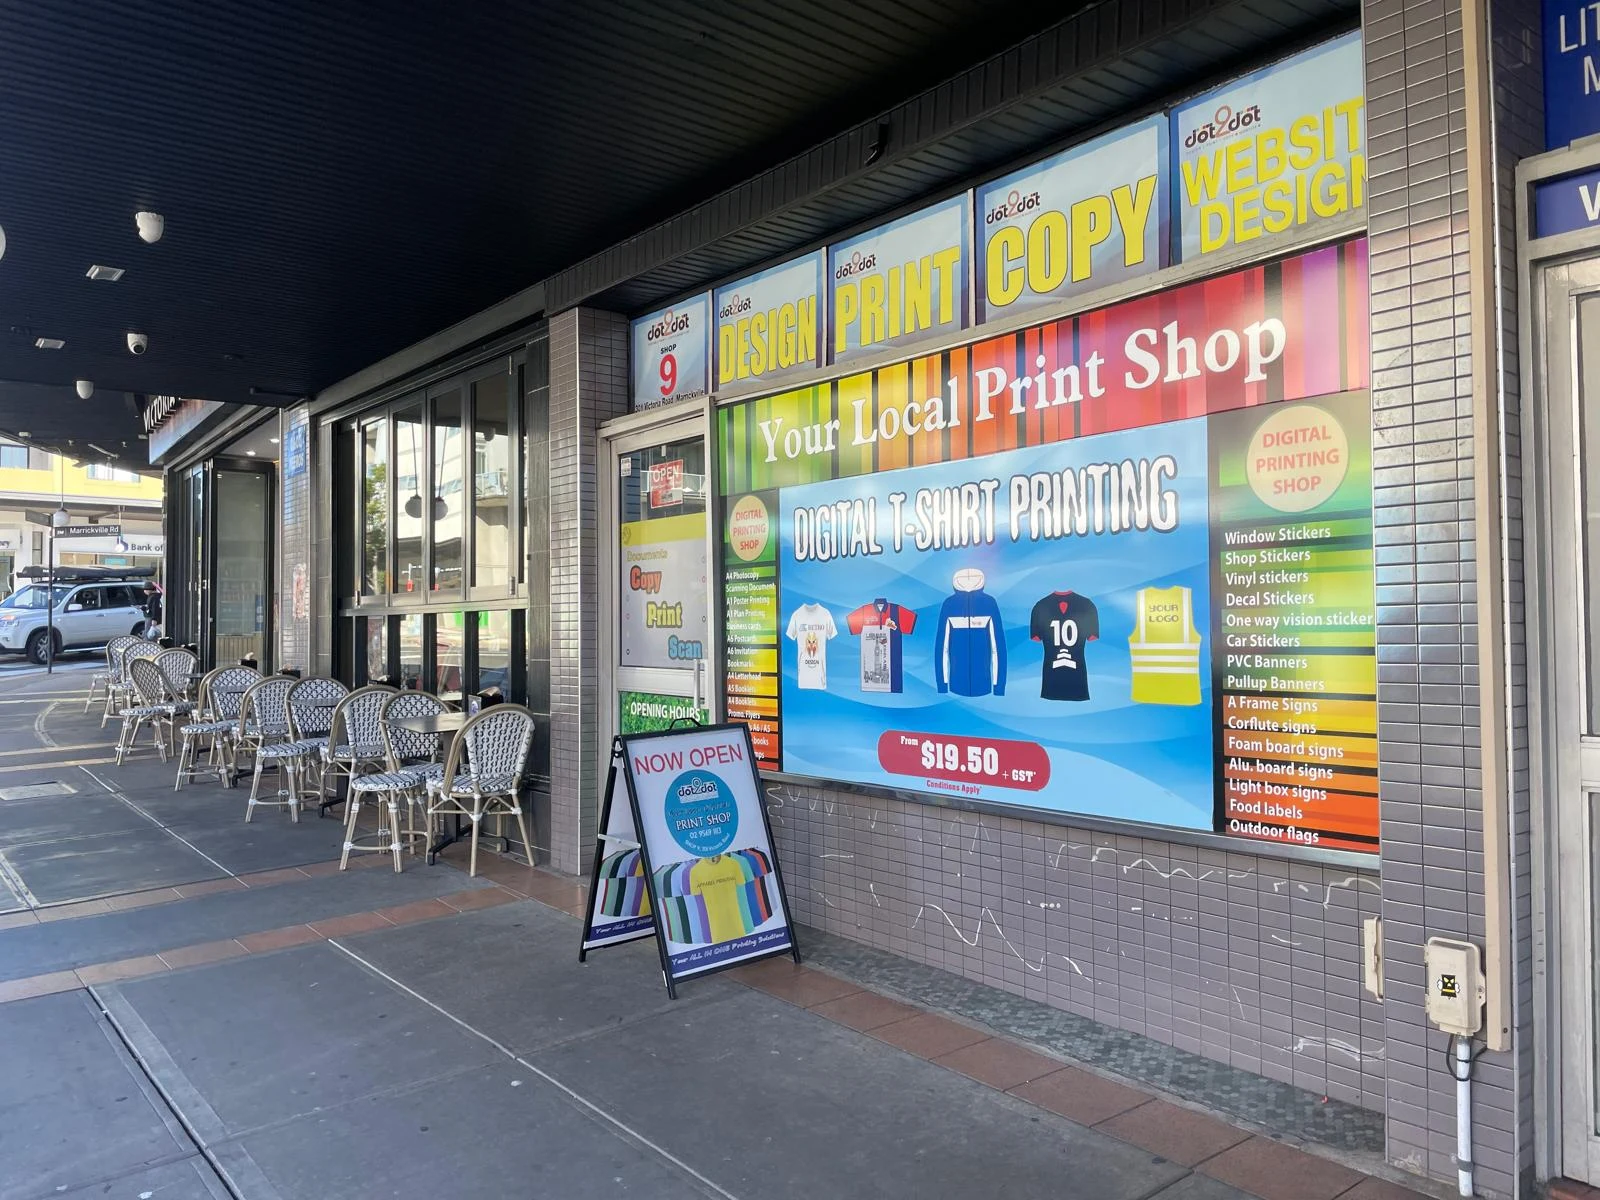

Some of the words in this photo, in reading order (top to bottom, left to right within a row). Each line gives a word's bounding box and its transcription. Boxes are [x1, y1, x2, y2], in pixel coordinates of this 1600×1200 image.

[1185, 105, 1261, 148] dot2dot
[1181, 96, 1365, 207] WEBSIT
[986, 190, 1040, 224] dot2dot
[986, 174, 1158, 307] COPY
[836, 251, 877, 280] dot2dot
[720, 294, 752, 319] dot2dot
[836, 245, 961, 353] PRINT
[647, 309, 689, 341] dot2dot
[660, 343, 676, 354] SHOP
[719, 295, 817, 385] DESIGN
[660, 353, 677, 396] 9
[759, 415, 840, 464] Your
[852, 376, 961, 447] Local
[975, 349, 1105, 421] Print
[1124, 316, 1286, 390] Shop
[1263, 425, 1332, 449] DIGITAL
[1256, 448, 1340, 473] PRINTING
[652, 464, 680, 483] OPEN
[1273, 475, 1322, 495] SHOP
[735, 509, 763, 521] DIGITAL
[793, 496, 883, 562] DIGITAL
[888, 478, 1000, 553] T-SHIRT
[1008, 454, 1179, 543] PRINTING
[70, 526, 108, 534] Marrickville
[732, 523, 766, 537] PRINTING
[1224, 529, 1276, 545] Window
[1278, 525, 1331, 542] Stickers
[131, 543, 152, 551] Bank
[740, 539, 760, 550] SHOP
[1225, 551, 1257, 567] Shop
[1260, 548, 1311, 563] Stickers
[630, 565, 662, 594] Copy
[726, 572, 733, 580] A4
[733, 571, 759, 580] Photocopy
[1225, 571, 1257, 588] Vinyl
[1259, 569, 1309, 584] stickers
[1148, 603, 1179, 613] YOUR
[1226, 592, 1260, 607] Decal
[1263, 590, 1315, 605] Stickers
[646, 601, 683, 628] Print
[1148, 613, 1180, 623] LOGO
[1226, 614, 1252, 627] One
[1254, 616, 1280, 629] way
[1283, 613, 1323, 626] vision
[1326, 611, 1373, 626] sticker
[1050, 619, 1078, 647] 10
[1226, 634, 1247, 648] Car
[1250, 634, 1300, 648] Stickers
[668, 634, 703, 660] Scan
[1227, 654, 1252, 668] PVC
[1254, 655, 1308, 669] Banners
[1227, 675, 1267, 692] Pullup
[1270, 676, 1325, 691] Banners
[630, 701, 668, 719] OPENING
[669, 704, 701, 721] HOURS
[745, 711, 761, 720] Flyers
[1228, 696, 1237, 709] A
[1239, 696, 1279, 710] Frame
[1282, 697, 1319, 715] Signs
[1228, 715, 1279, 731] Corflute
[1282, 718, 1317, 735] signs
[900, 735, 919, 746] From
[921, 739, 998, 776] $19.50
[1228, 736, 1263, 752] Foam
[1266, 738, 1305, 755] board
[1308, 742, 1344, 760] signs
[634, 752, 683, 776] NOW
[689, 743, 743, 768] OPEN
[1229, 758, 1254, 772] Alu.
[1256, 759, 1295, 776] board
[1298, 763, 1334, 781] signs
[678, 777, 717, 797] dot2dot
[926, 779, 960, 792] Conditions
[1229, 778, 1262, 796] Light
[1264, 780, 1289, 796] box
[1292, 784, 1327, 802] signs
[1229, 798, 1262, 815] Food
[1264, 801, 1303, 819] labels
[676, 816, 704, 831] PRINT
[706, 812, 731, 826] SHOP
[1230, 819, 1285, 837] Outdoor
[1287, 825, 1319, 844] flags
